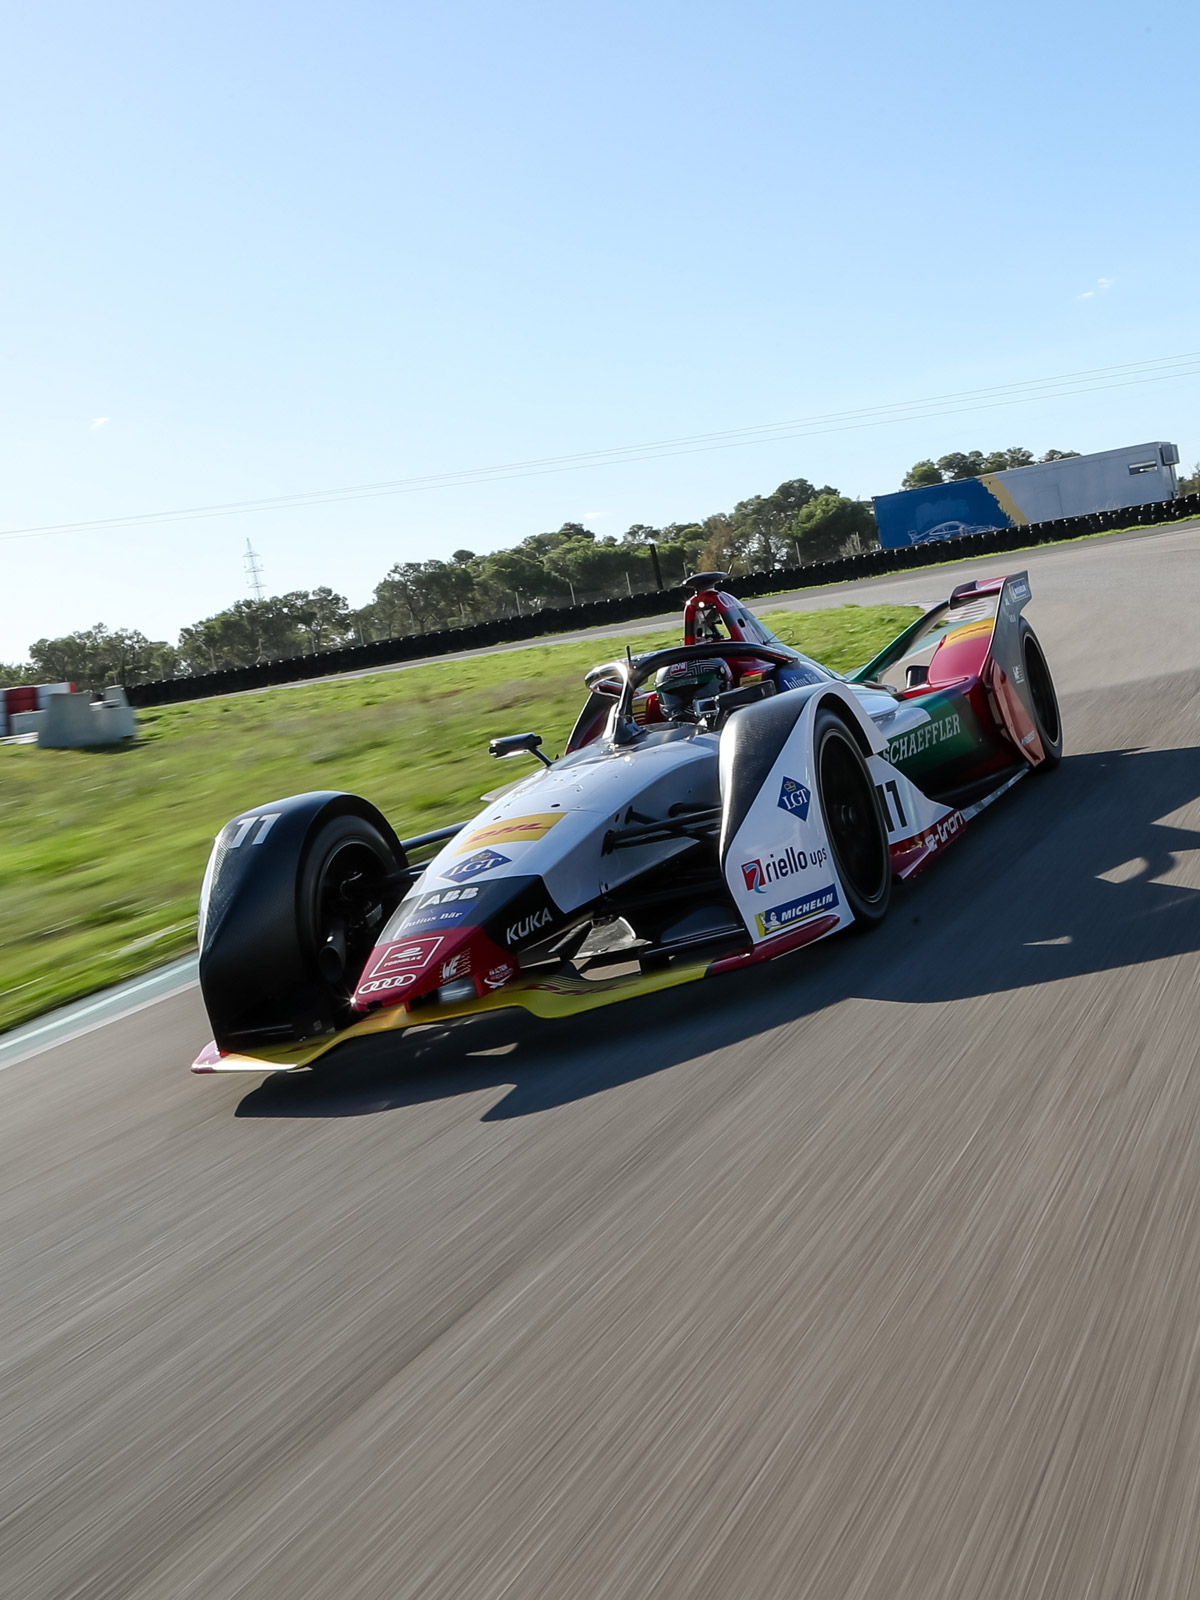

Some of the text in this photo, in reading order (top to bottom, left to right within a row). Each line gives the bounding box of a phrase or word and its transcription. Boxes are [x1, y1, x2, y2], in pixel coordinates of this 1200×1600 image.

[882, 713, 961, 764] SCHAEFFLER
[782, 788, 808, 810] LGT
[925, 811, 964, 851] e-tron
[450, 857, 502, 876] LGT
[765, 847, 827, 883] riello ups
[419, 887, 480, 909] ABB
[781, 893, 833, 922] MICHELIN
[404, 911, 462, 929] Julius Bär
[506, 907, 553, 945] KUKA
